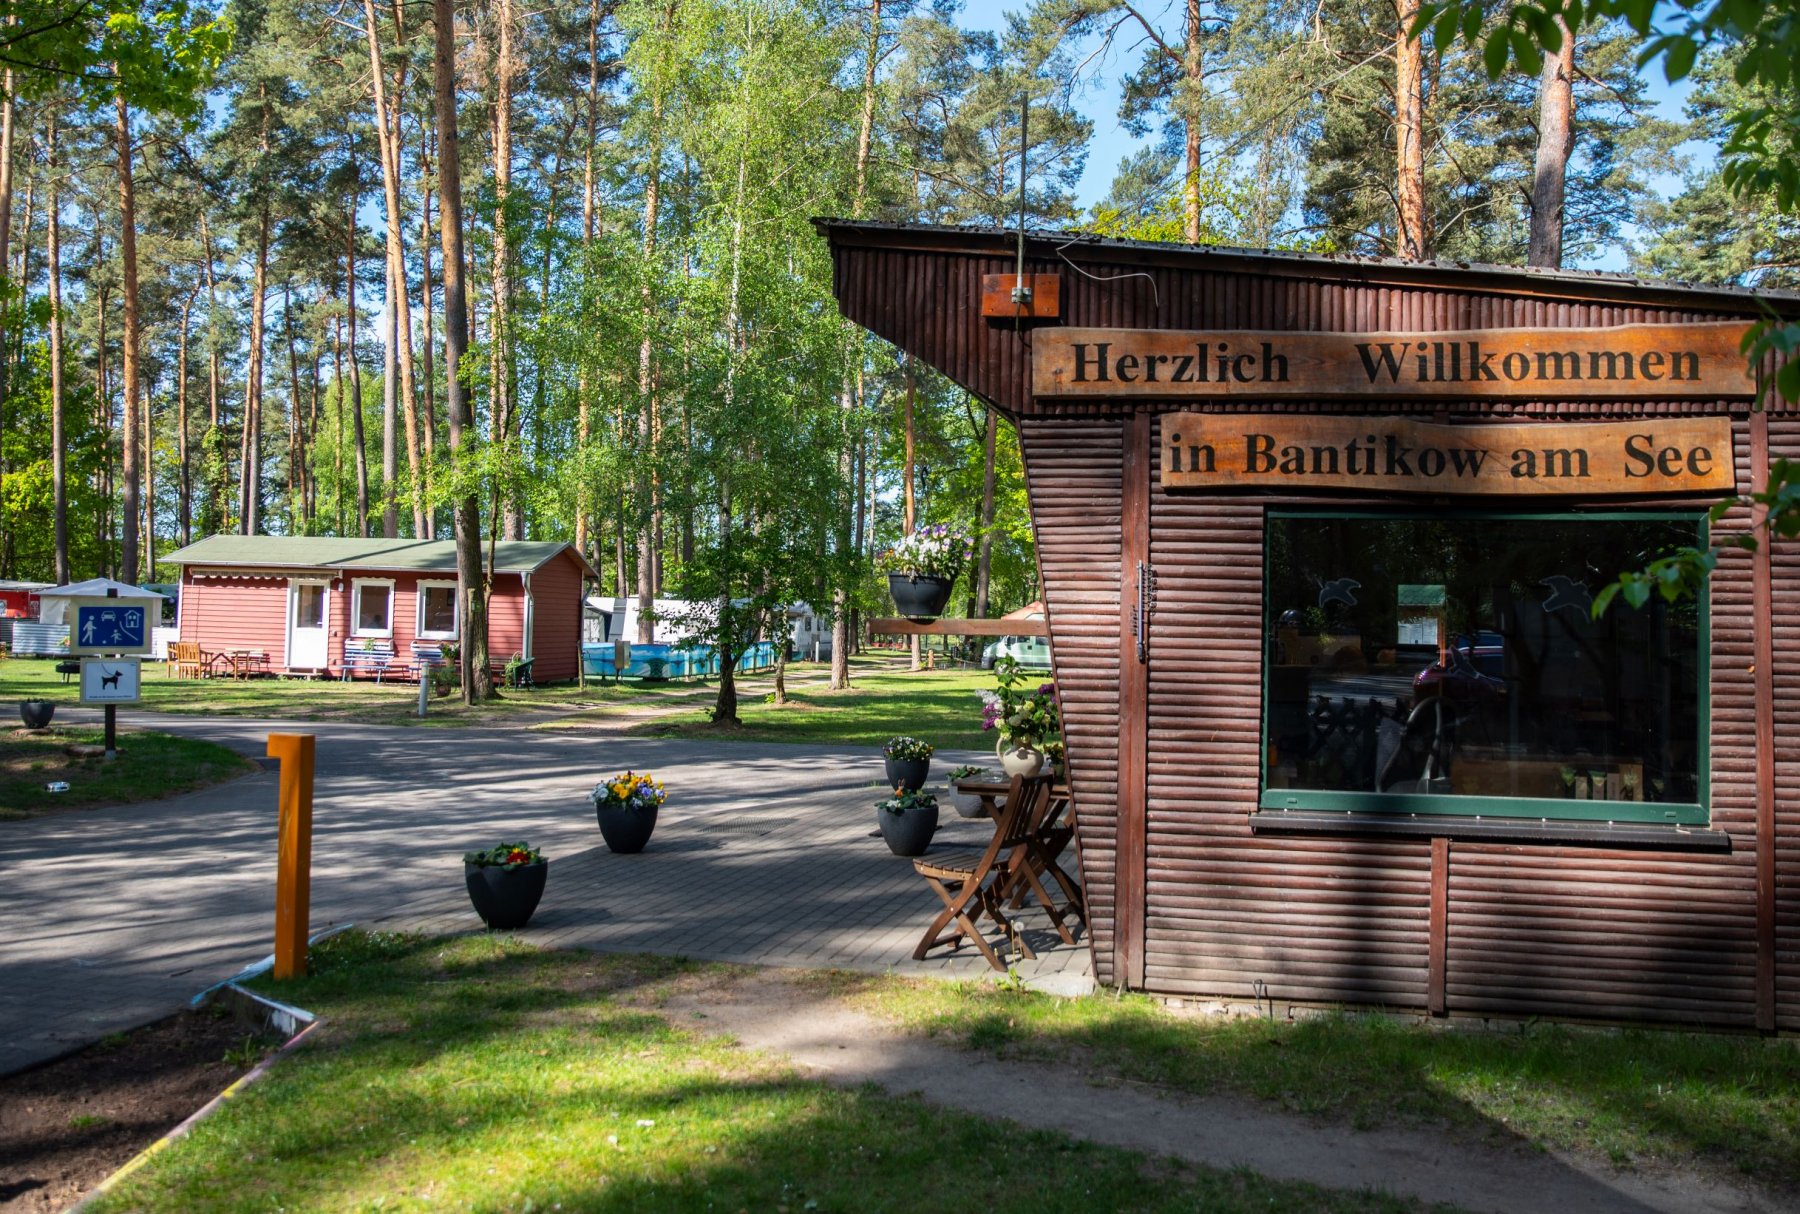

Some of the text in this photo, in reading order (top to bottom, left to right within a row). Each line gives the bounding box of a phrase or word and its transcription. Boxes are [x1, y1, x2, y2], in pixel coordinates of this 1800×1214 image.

[1071, 341, 1702, 384] Herzlich Willkommen
[1169, 433, 1713, 478] in Bantikow am See
